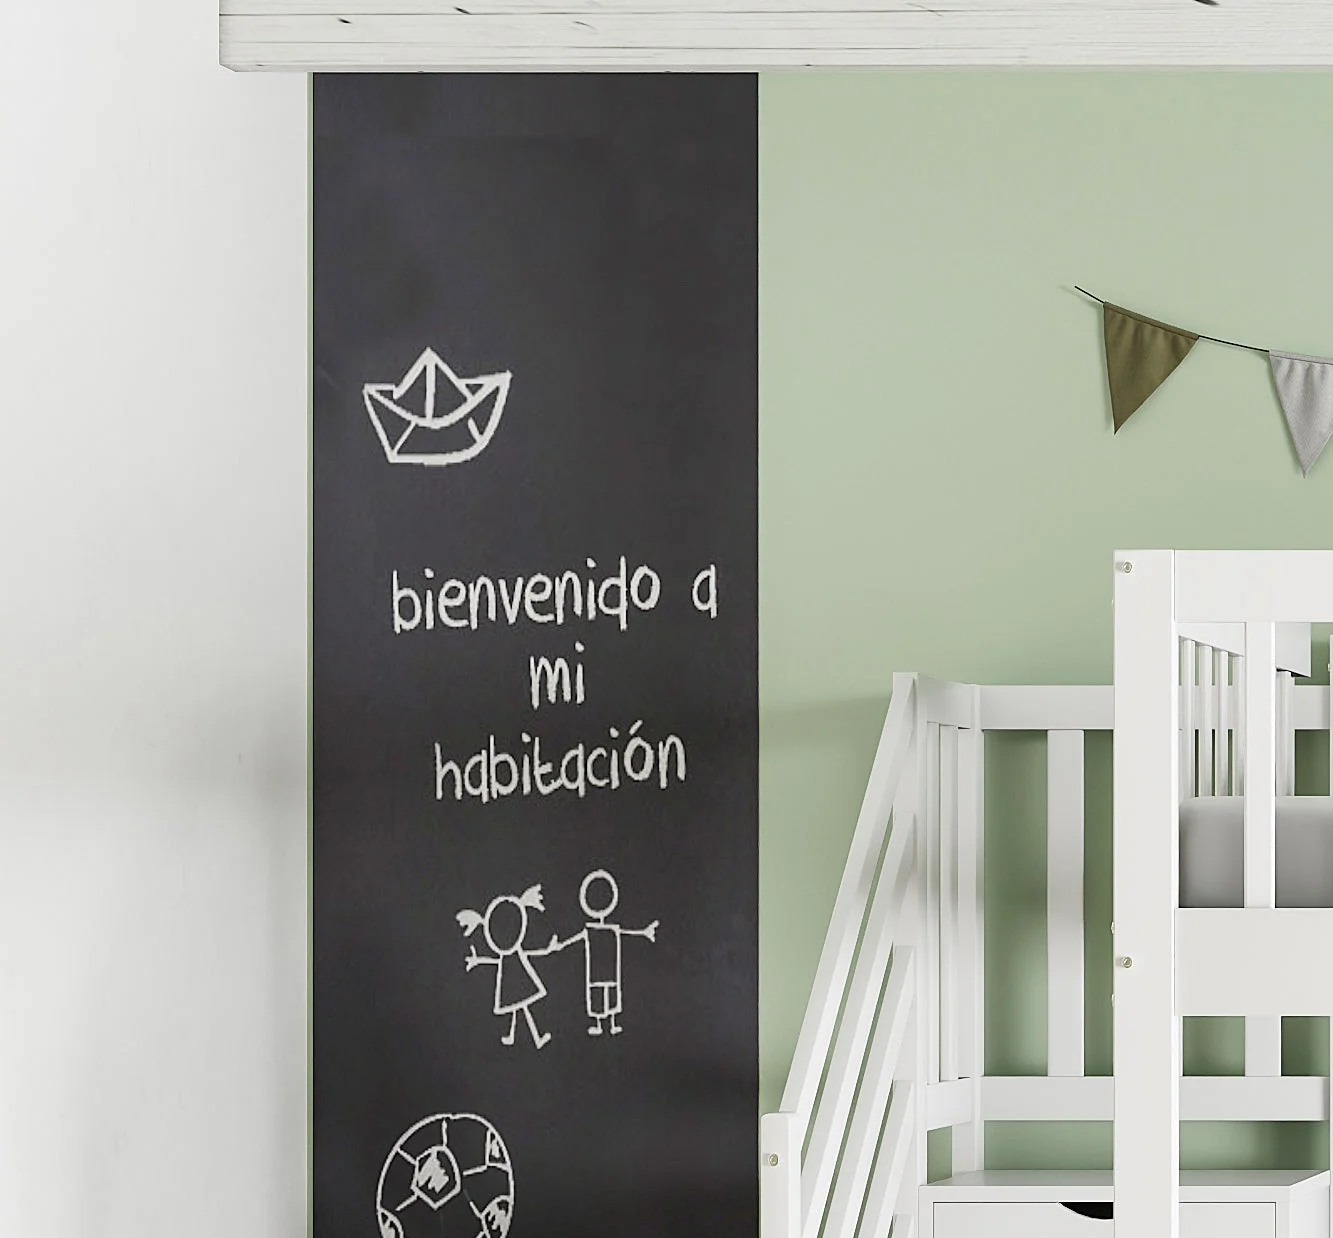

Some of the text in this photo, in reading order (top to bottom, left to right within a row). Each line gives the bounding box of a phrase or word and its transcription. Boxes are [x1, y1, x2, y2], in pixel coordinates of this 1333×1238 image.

[392, 555, 718, 635] bienvenido a
[529, 641, 585, 710] mi
[434, 719, 686, 804] habitación
